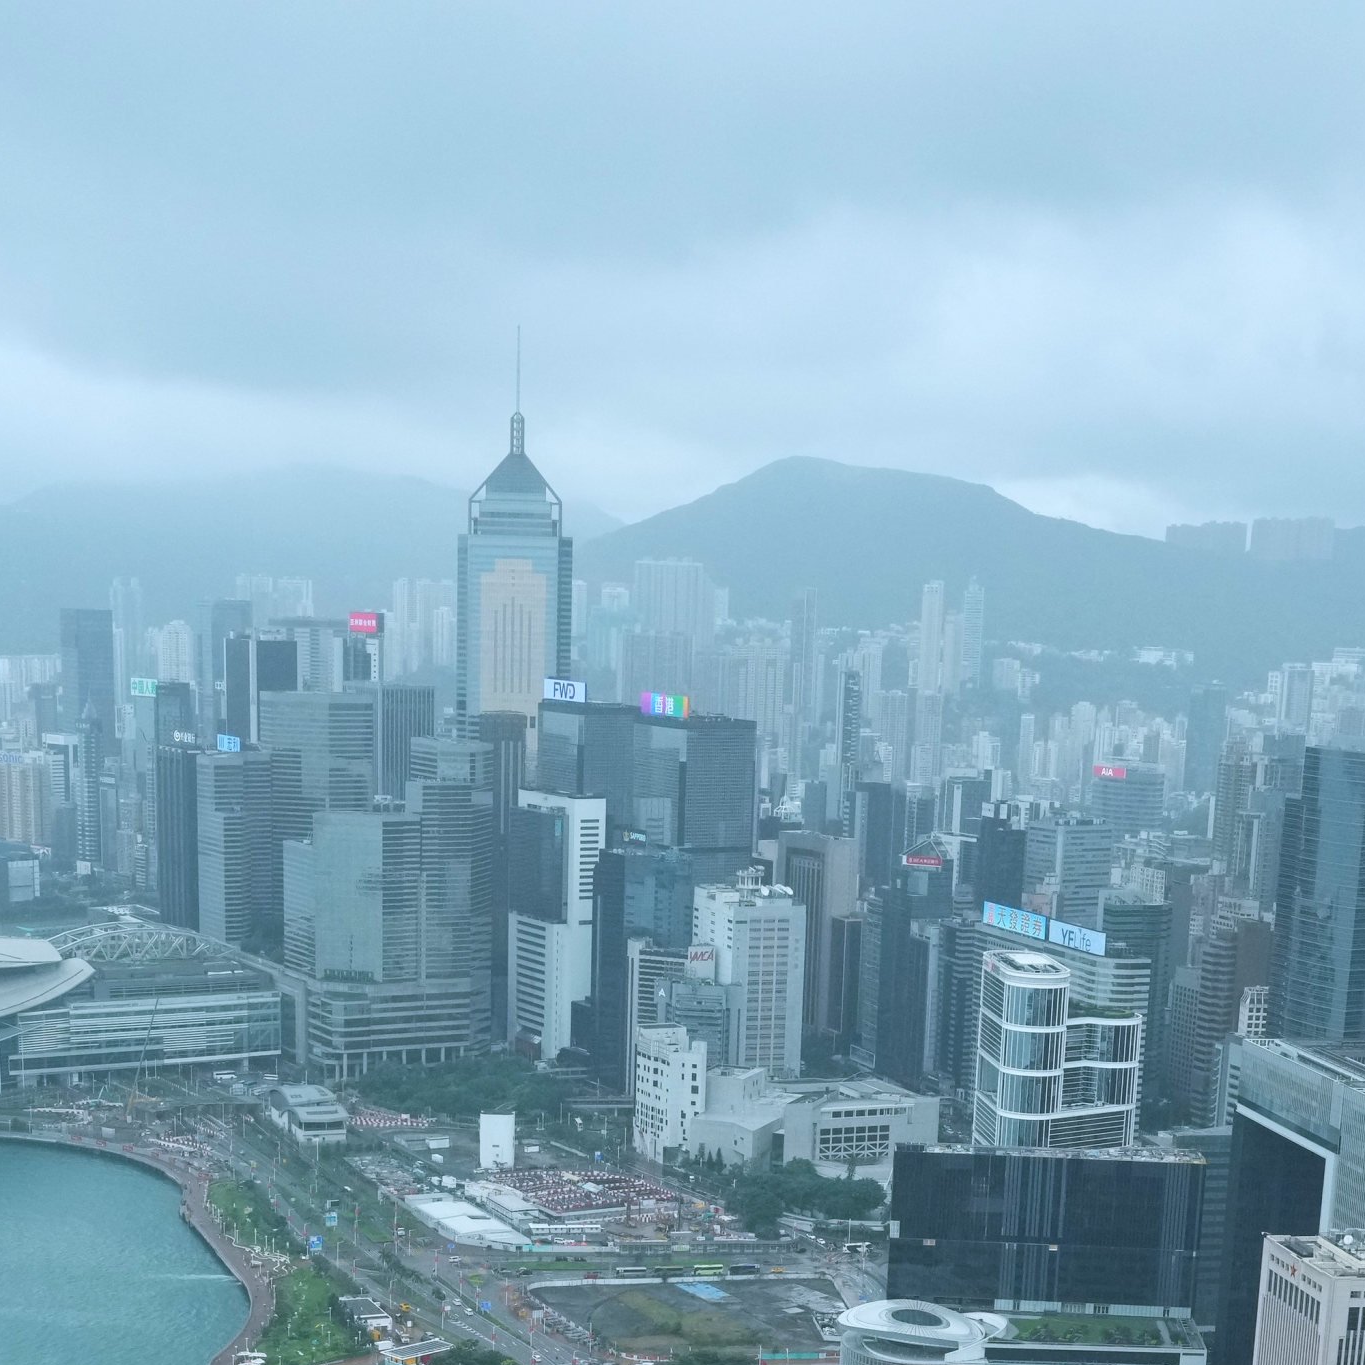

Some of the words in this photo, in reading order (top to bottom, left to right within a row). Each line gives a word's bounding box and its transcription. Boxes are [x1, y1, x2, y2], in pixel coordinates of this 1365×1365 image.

[553, 682, 576, 699] FWD
[655, 696, 674, 715] 香港
[1101, 767, 1114, 777] AIA
[689, 948, 714, 964] YMCA
